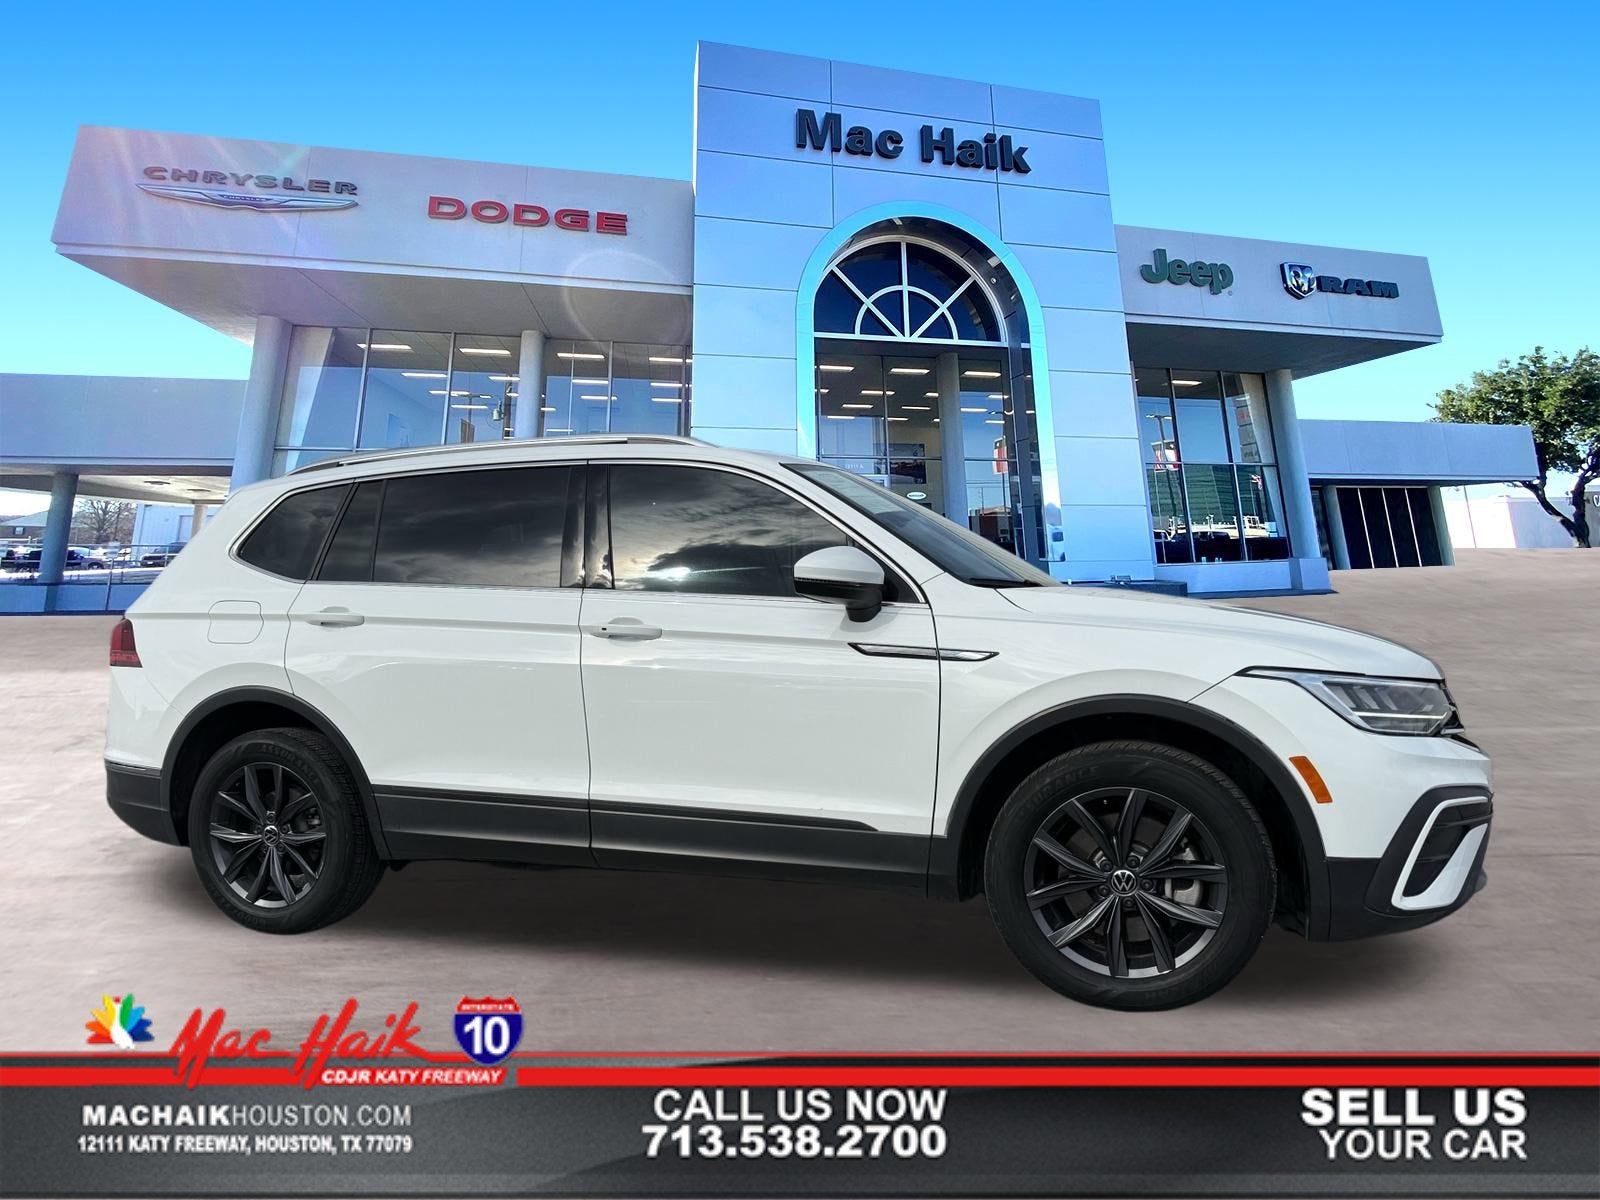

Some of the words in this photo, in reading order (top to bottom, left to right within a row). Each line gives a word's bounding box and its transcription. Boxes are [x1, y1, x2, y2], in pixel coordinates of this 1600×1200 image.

[796, 108, 904, 160] Mac
[919, 124, 1032, 174] Haik
[143, 166, 358, 196] CHRYSLER
[428, 196, 628, 236] DODGE
[1140, 248, 1234, 295] Jeep
[1316, 275, 1399, 299] RAM
